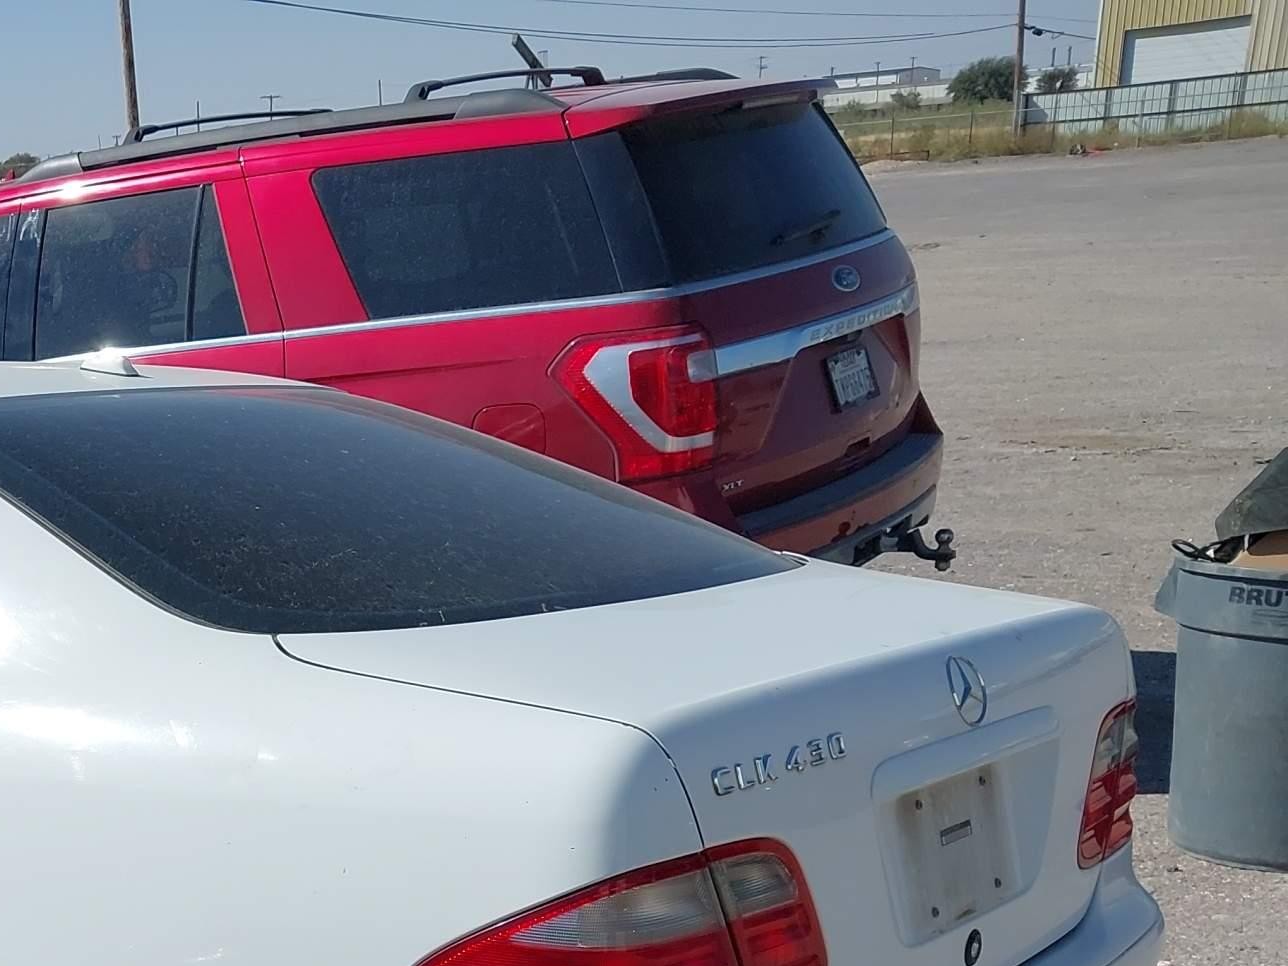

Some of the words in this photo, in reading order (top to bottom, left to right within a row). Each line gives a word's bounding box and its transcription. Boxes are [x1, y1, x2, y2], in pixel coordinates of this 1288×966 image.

[811, 295, 911, 341] EXPEDITION
[711, 753, 778, 796] CLK
[785, 732, 847, 771] 430
